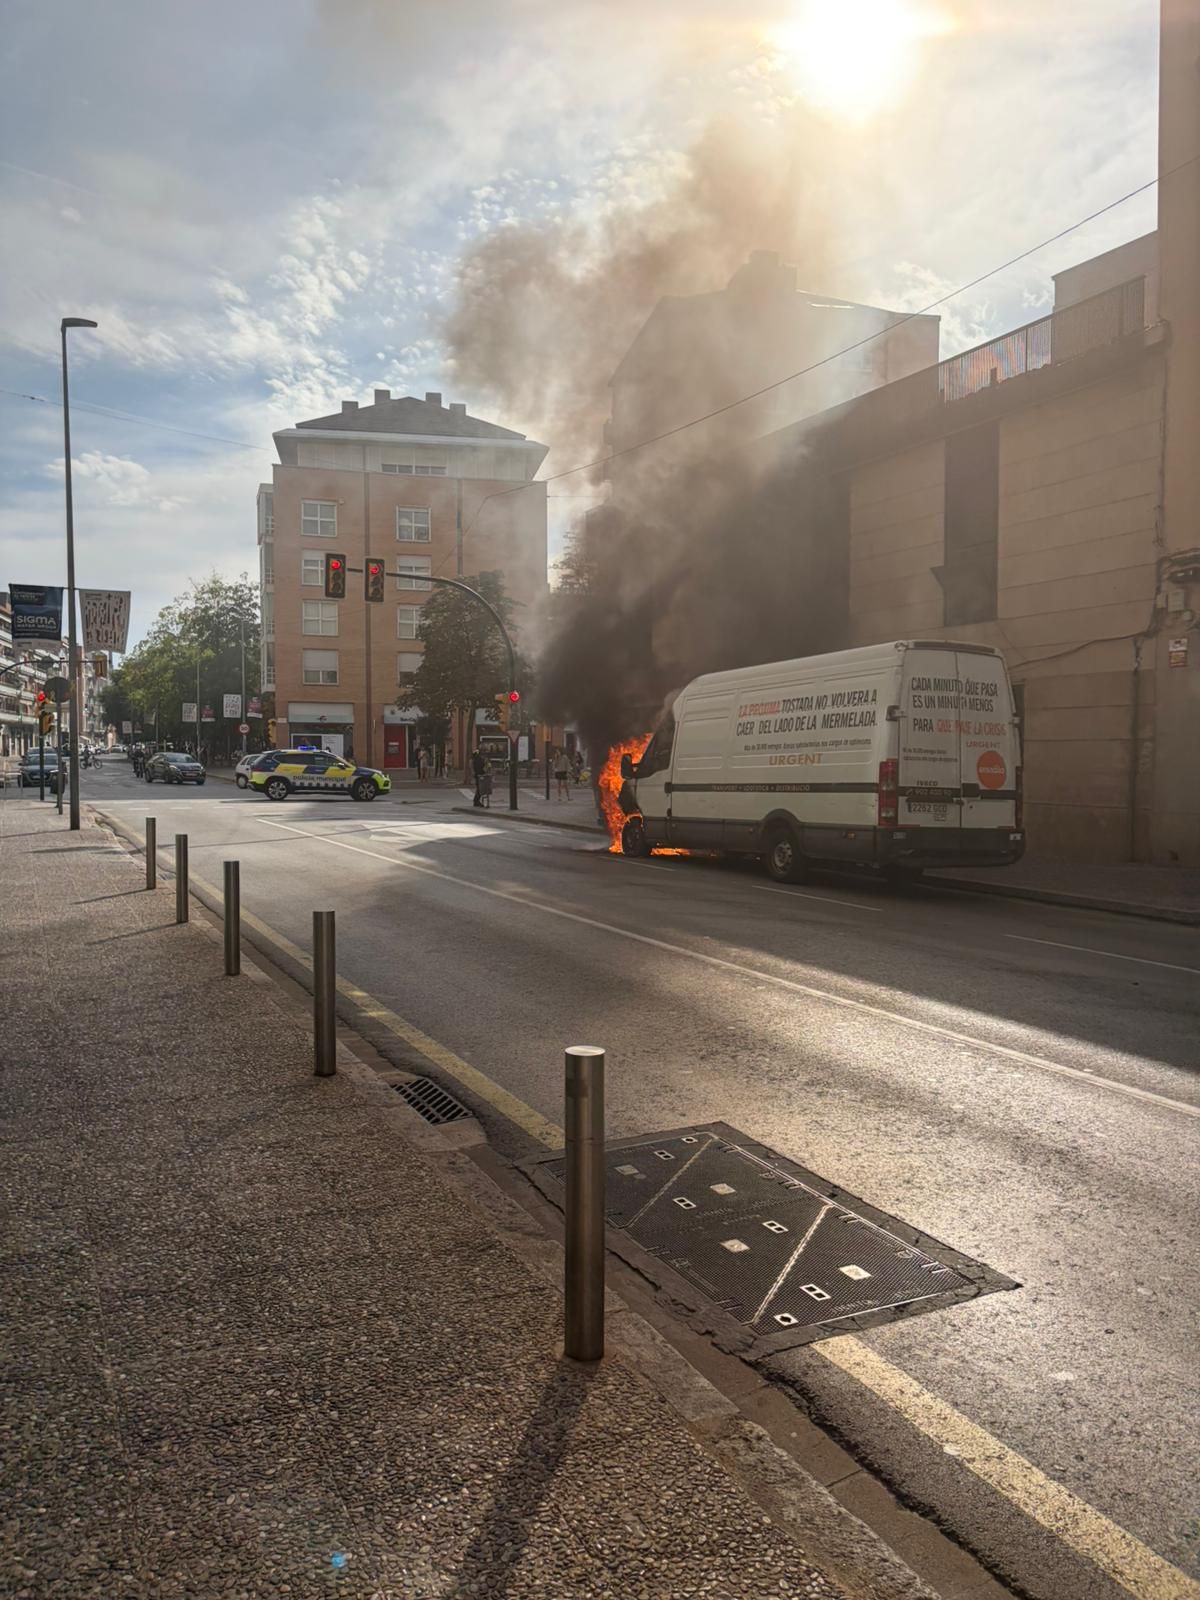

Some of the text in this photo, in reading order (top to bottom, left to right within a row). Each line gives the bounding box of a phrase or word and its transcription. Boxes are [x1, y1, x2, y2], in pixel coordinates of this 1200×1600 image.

[911, 677, 932, 691] CADA
[965, 679, 979, 696] QUE
[980, 681, 998, 697] PASA
[781, 695, 814, 714] TOSTADA
[814, 694, 827, 711] NO
[870, 688, 877, 705] A
[912, 694, 923, 709] ES
[924, 695, 936, 709] UN
[968, 697, 994, 712] MENOS
[736, 721, 755, 736] CAER
[758, 719, 772, 734] DEL
[773, 716, 794, 733] LADO
[795, 716, 806, 732] DE
[806, 714, 817, 730] LA
[913, 718, 934, 732] PARA
[768, 753, 823, 766] URGENT
